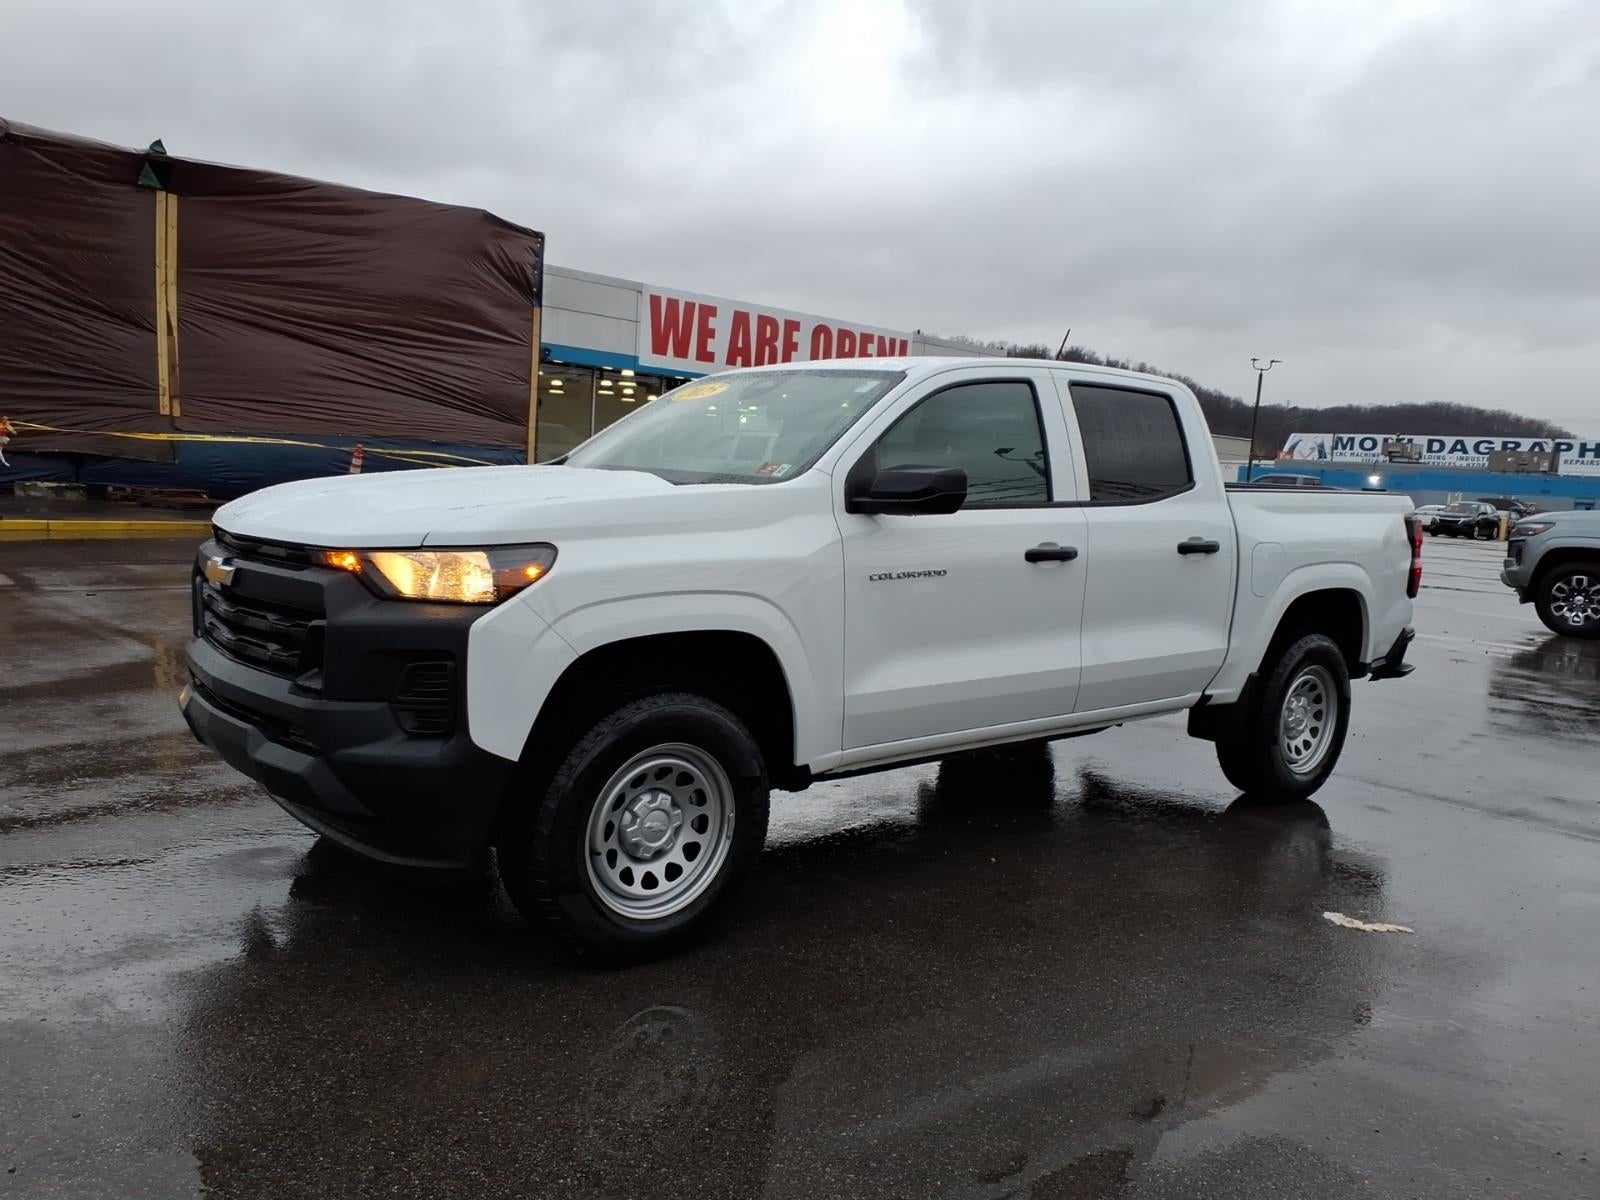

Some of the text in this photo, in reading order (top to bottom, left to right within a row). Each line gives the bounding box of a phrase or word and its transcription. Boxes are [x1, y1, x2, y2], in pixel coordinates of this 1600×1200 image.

[649, 294, 717, 363] WE
[725, 310, 801, 368] ARE
[869, 569, 947, 581] COLORADO
